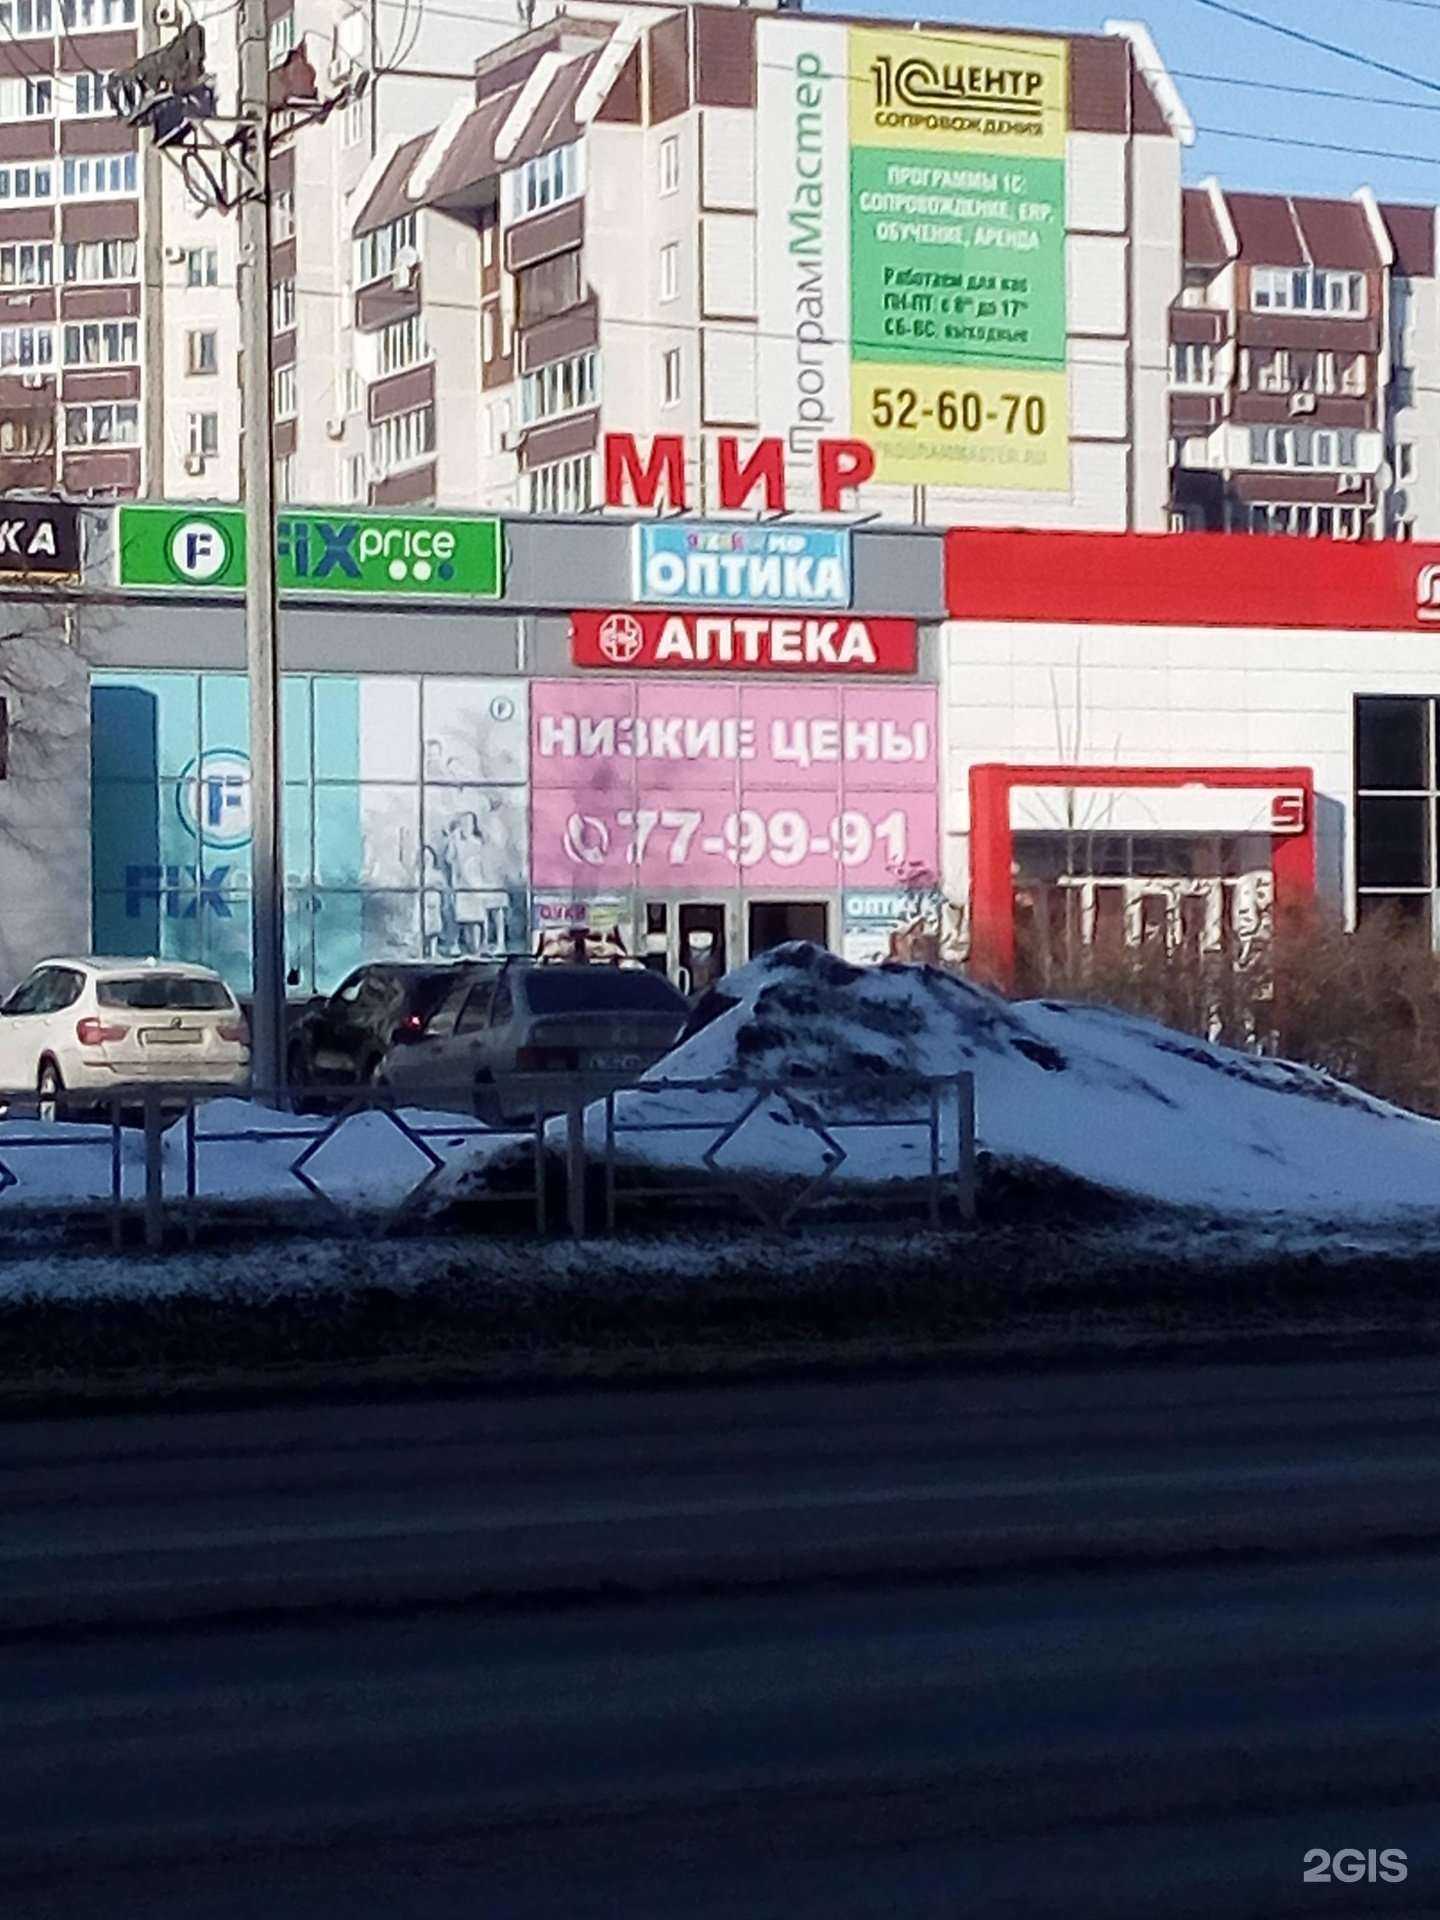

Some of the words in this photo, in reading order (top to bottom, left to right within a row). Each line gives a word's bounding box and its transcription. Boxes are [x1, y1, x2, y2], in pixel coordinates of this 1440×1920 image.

[943, 66, 1042, 98] ЦЕНТР
[874, 111, 1042, 136] СОПРОВОЖДЕНИЯ
[872, 387, 1046, 436] 52-60-70
[604, 432, 876, 512] МИР
[359, 528, 456, 563] price
[646, 552, 844, 599] ОПТИКА
[655, 616, 877, 664] АПТЕКА
[538, 716, 756, 760] НИЗКИЕ
[771, 719, 929, 767] ЦЕНЫ
[616, 809, 909, 867] 77-99-91
